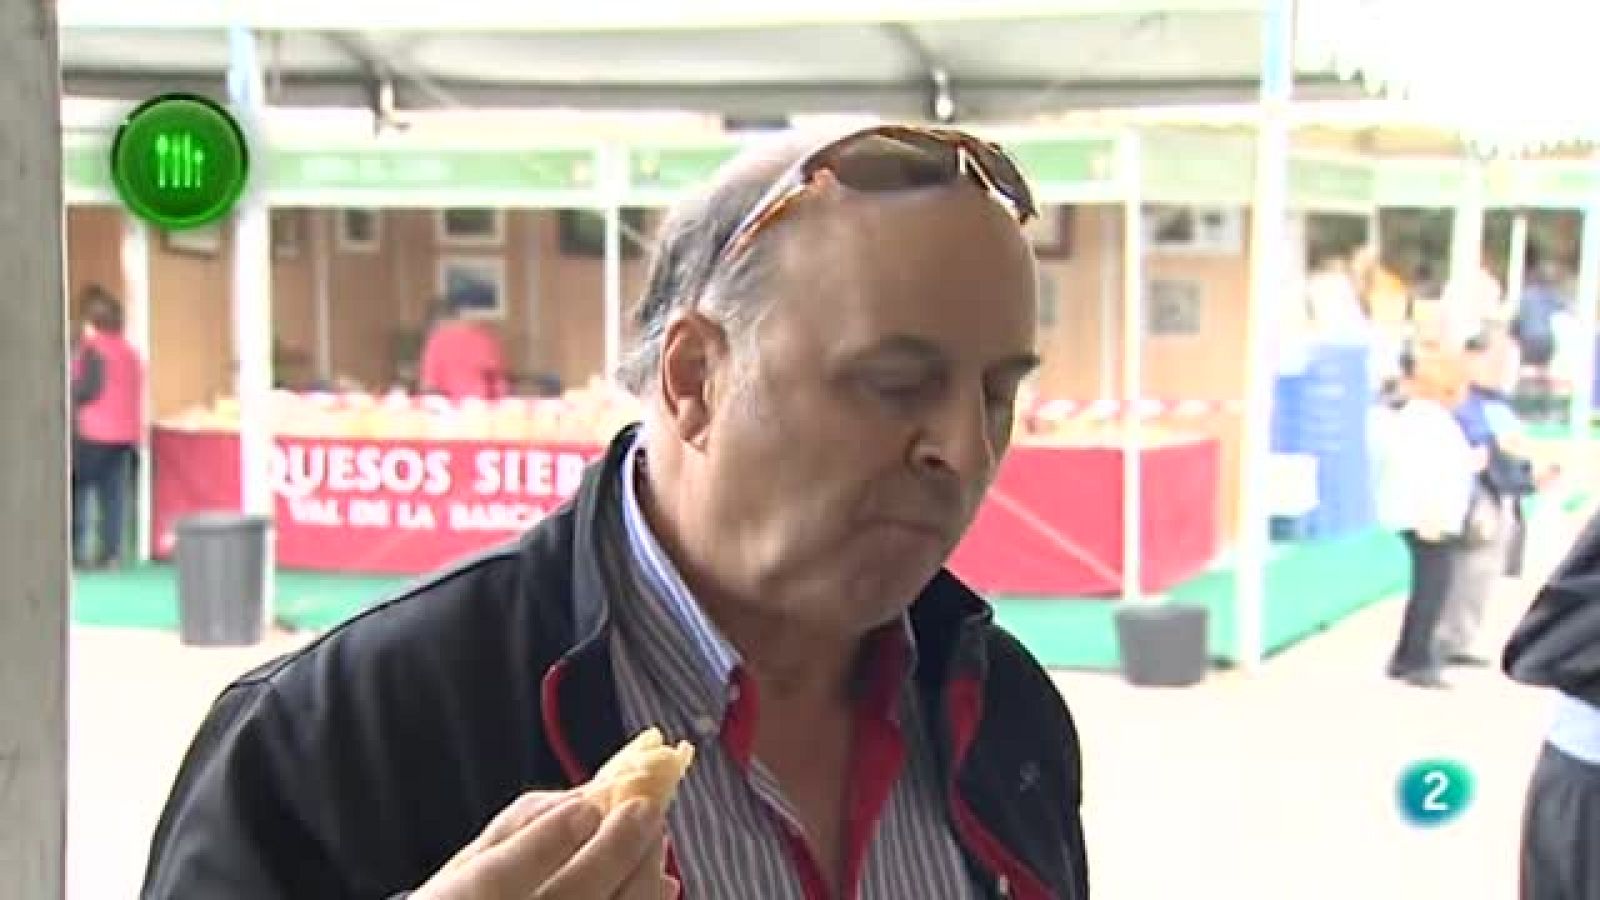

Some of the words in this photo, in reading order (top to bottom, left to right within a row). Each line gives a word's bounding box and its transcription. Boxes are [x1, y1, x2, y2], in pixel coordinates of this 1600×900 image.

[266, 446, 451, 497] QUESOS
[287, 499, 341, 526] VAL
[348, 499, 389, 527] DE
[397, 502, 435, 529] LA
